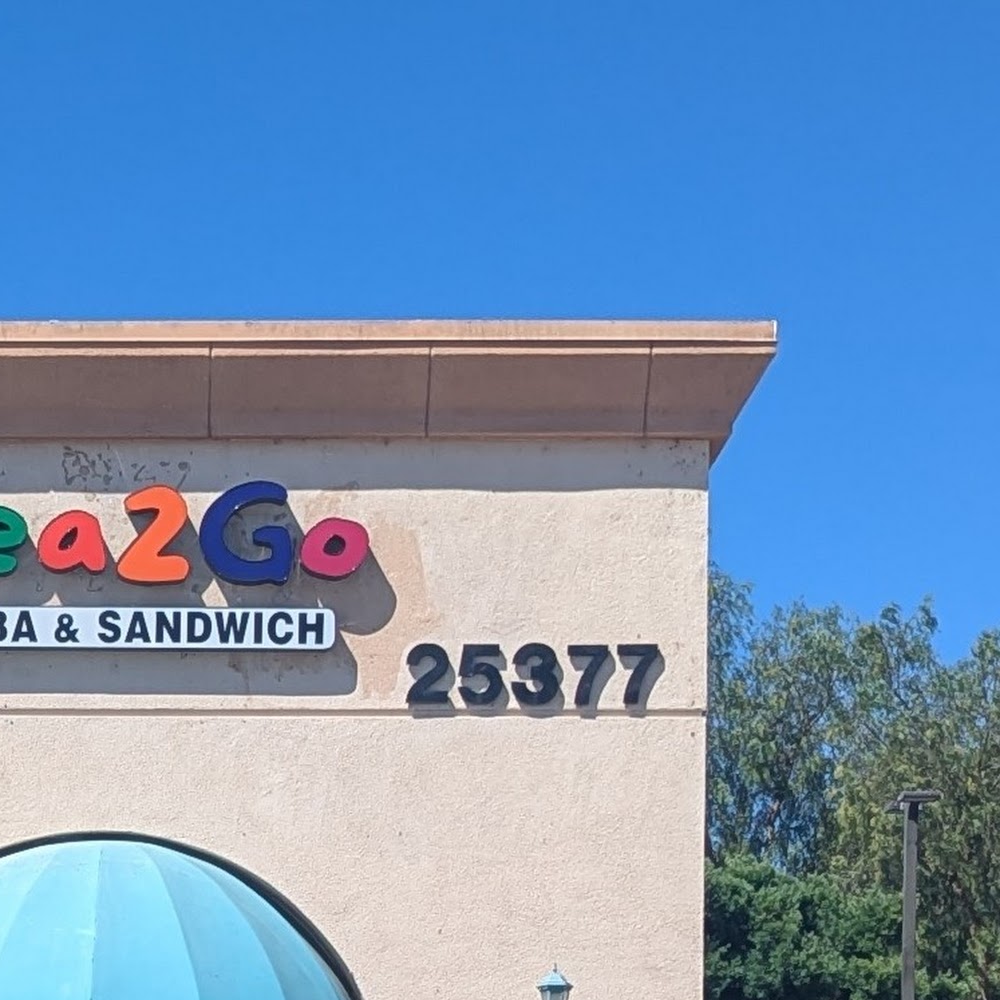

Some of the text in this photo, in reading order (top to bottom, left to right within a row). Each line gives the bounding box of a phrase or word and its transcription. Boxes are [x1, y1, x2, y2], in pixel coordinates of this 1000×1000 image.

[53, 612, 81, 645] &
[97, 610, 327, 646] SANDWICH
[405, 643, 661, 709] 25377
